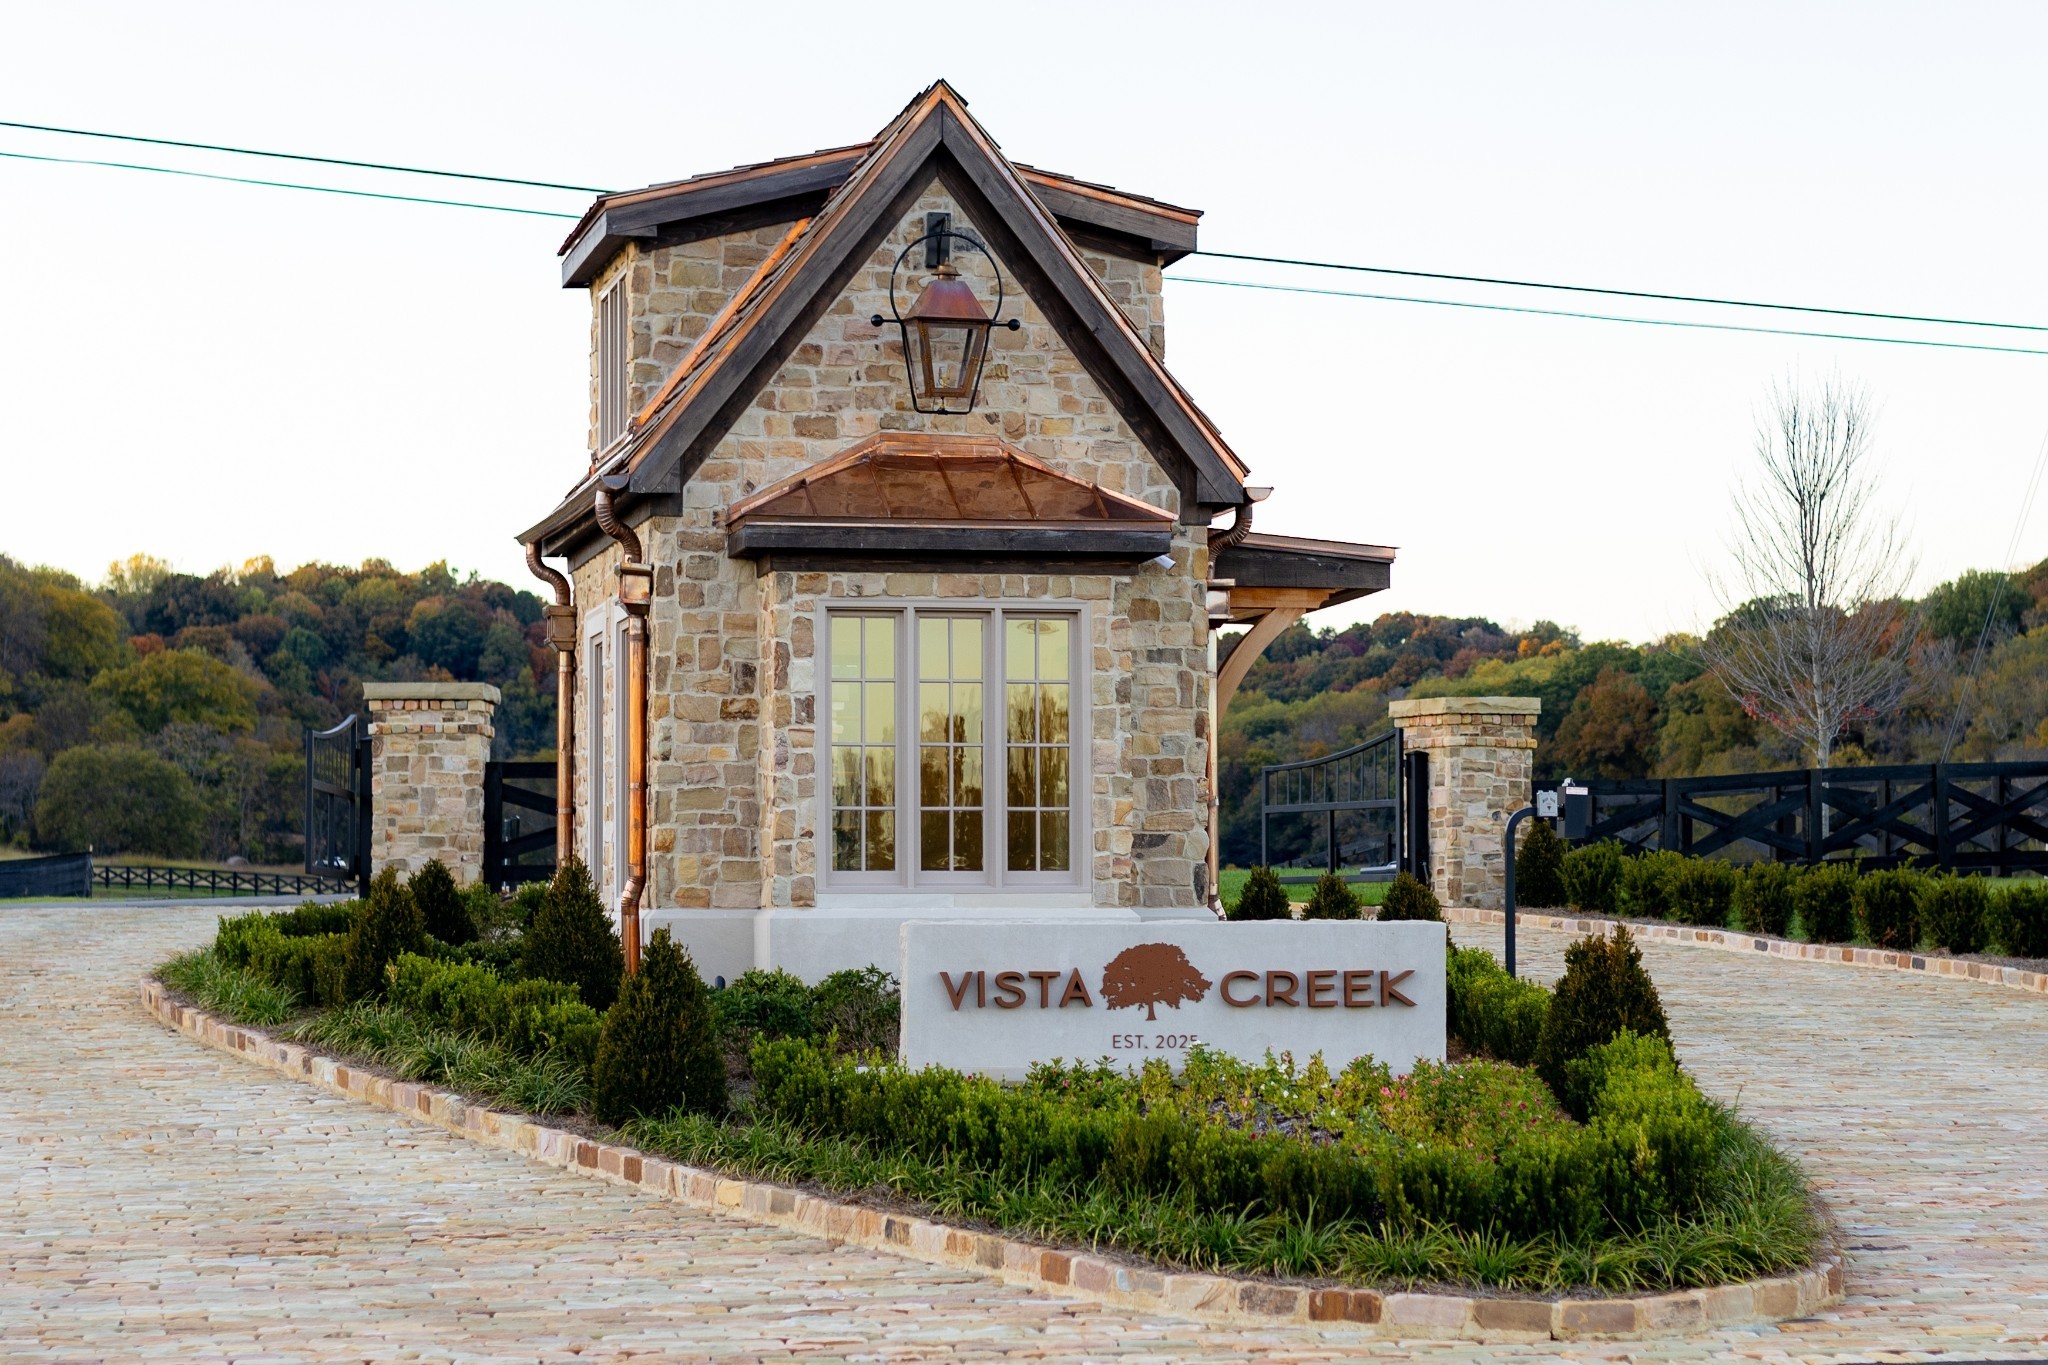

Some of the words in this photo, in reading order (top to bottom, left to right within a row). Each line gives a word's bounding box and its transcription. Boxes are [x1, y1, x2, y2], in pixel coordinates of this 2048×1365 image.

[939, 967, 1093, 1011] VISTA
[1220, 970, 1418, 1008] CREEK
[1112, 1034, 1148, 1049] EST.
